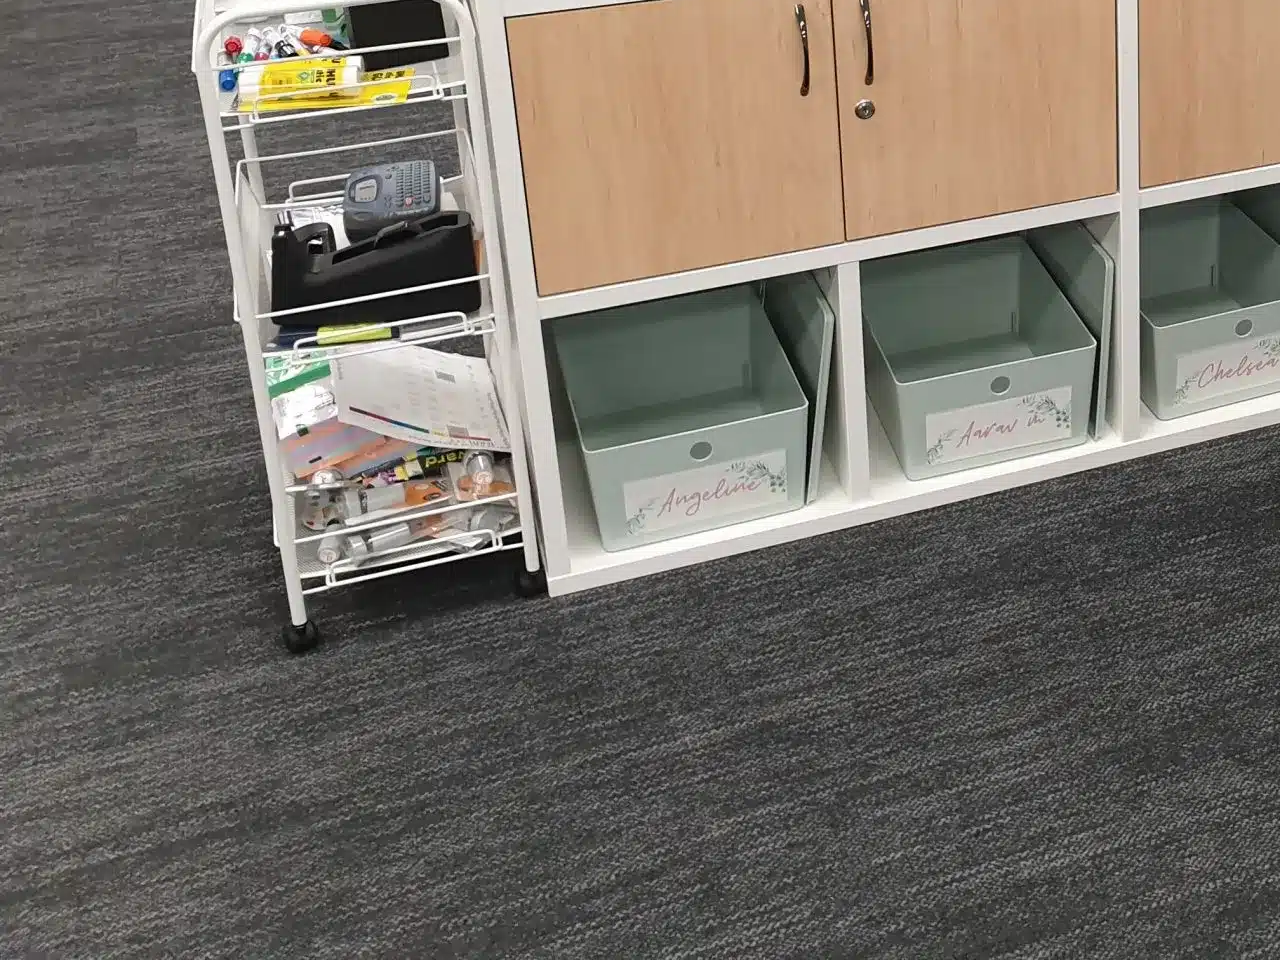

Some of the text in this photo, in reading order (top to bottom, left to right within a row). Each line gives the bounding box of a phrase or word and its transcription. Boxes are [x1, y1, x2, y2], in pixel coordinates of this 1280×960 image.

[1196, 355, 1280, 388] Chelsea
[955, 419, 1019, 449] Aarav
[658, 479, 761, 517] Angeline
